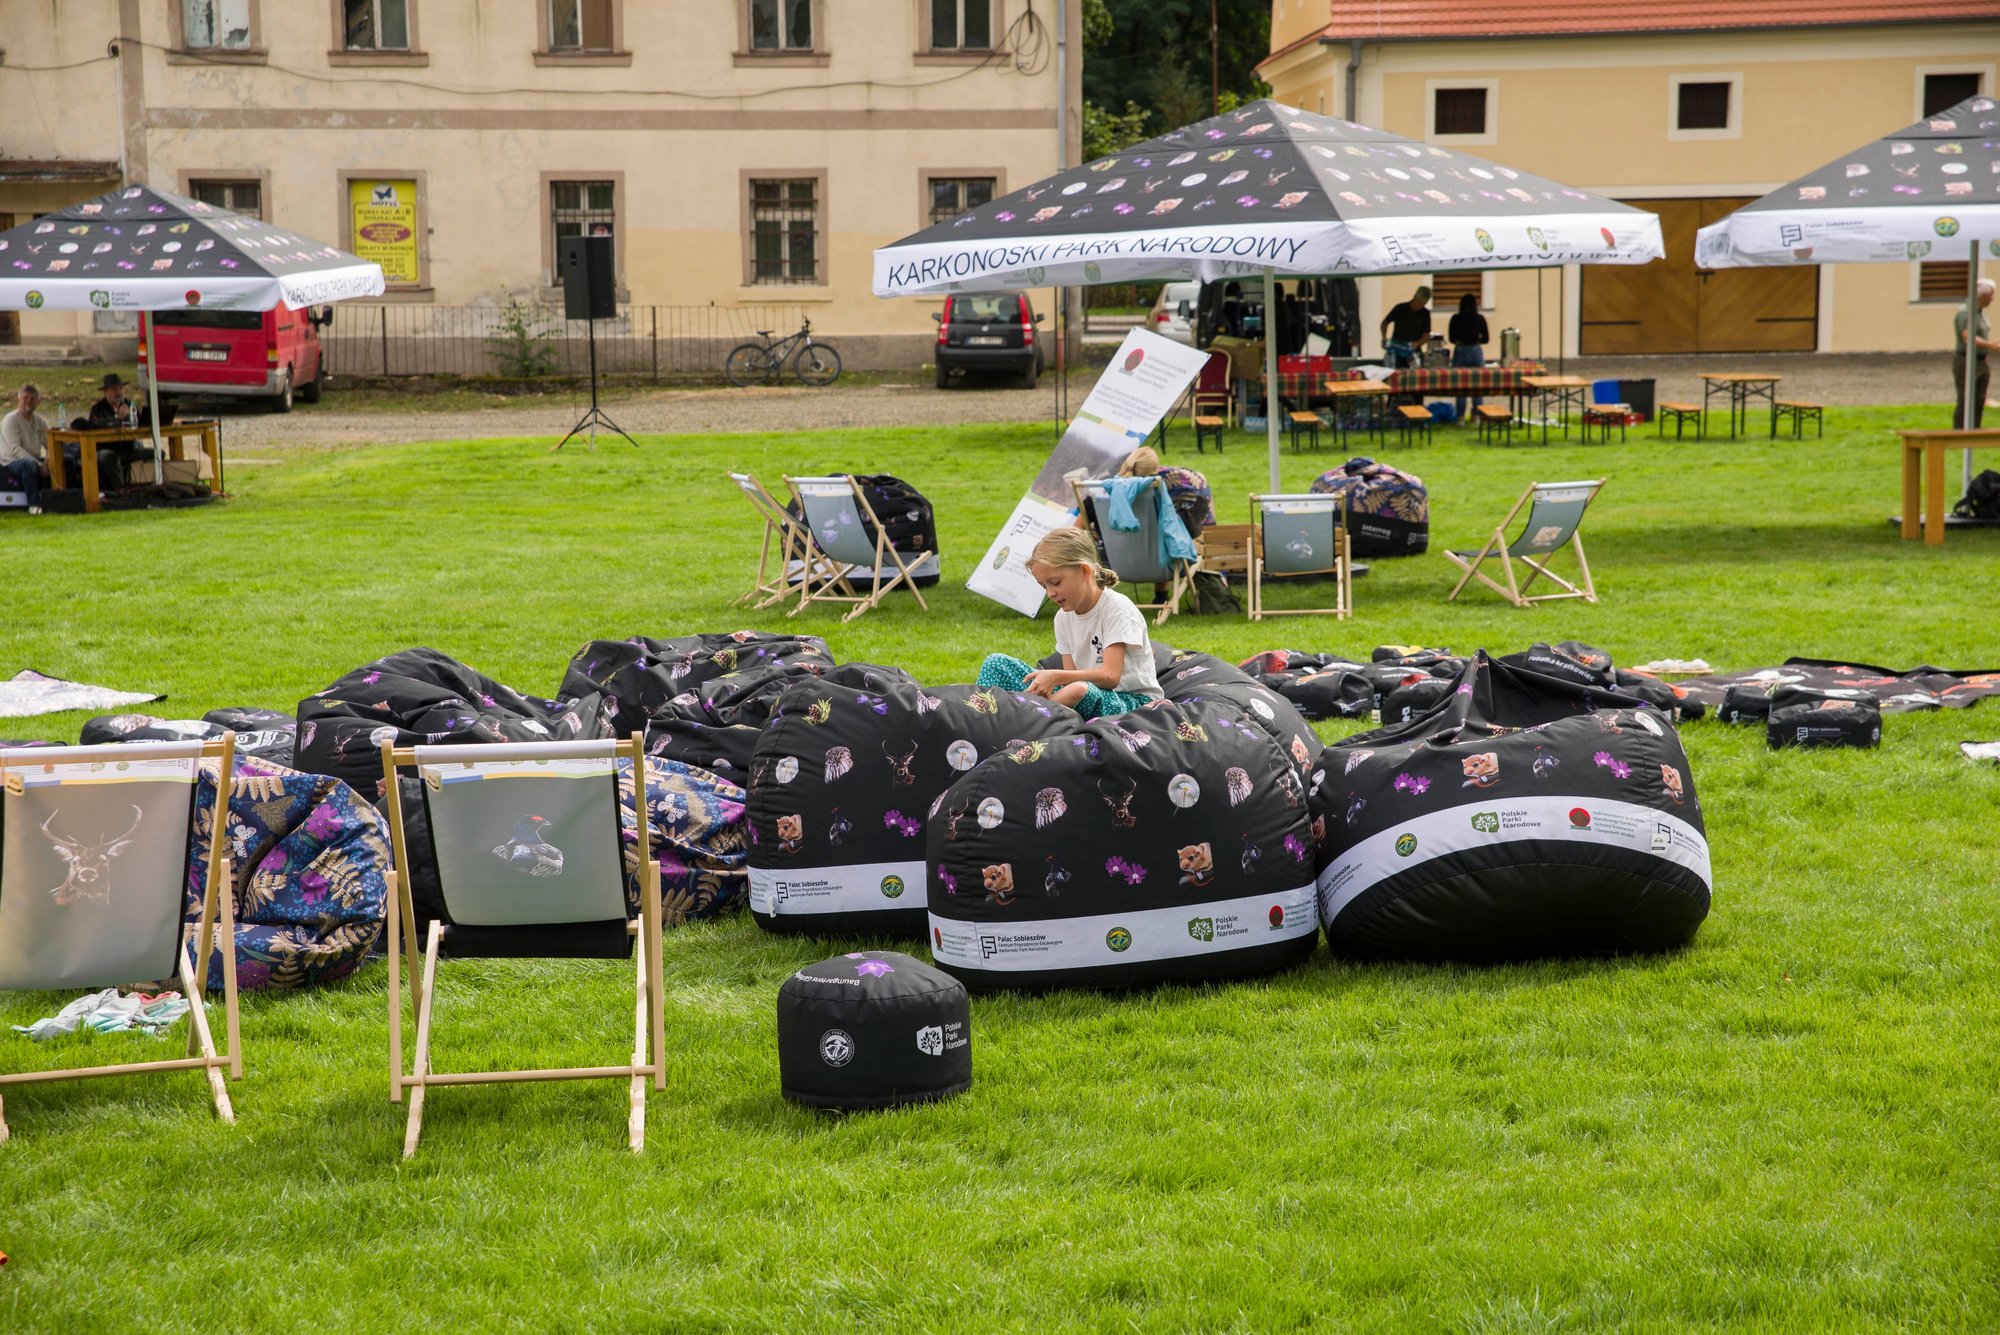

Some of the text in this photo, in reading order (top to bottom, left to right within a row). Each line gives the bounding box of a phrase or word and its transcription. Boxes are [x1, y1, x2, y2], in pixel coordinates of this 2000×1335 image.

[888, 244, 1047, 288] KARKONOSKI
[1052, 238, 1121, 259] PARK
[1129, 235, 1308, 263] NARODOWY
[1555, 660, 1596, 682] kratkowiec
[1503, 821, 1541, 829] Narodowe
[1331, 864, 1351, 883] Sobieszów
[1215, 915, 1238, 923] Polskie
[1216, 928, 1249, 937] Narodowe
[1013, 934, 1046, 942] Sobieszów
[944, 1022, 962, 1032] Polskie
[945, 1031, 958, 1041] Parki
[945, 1037, 968, 1050] Narodowe
